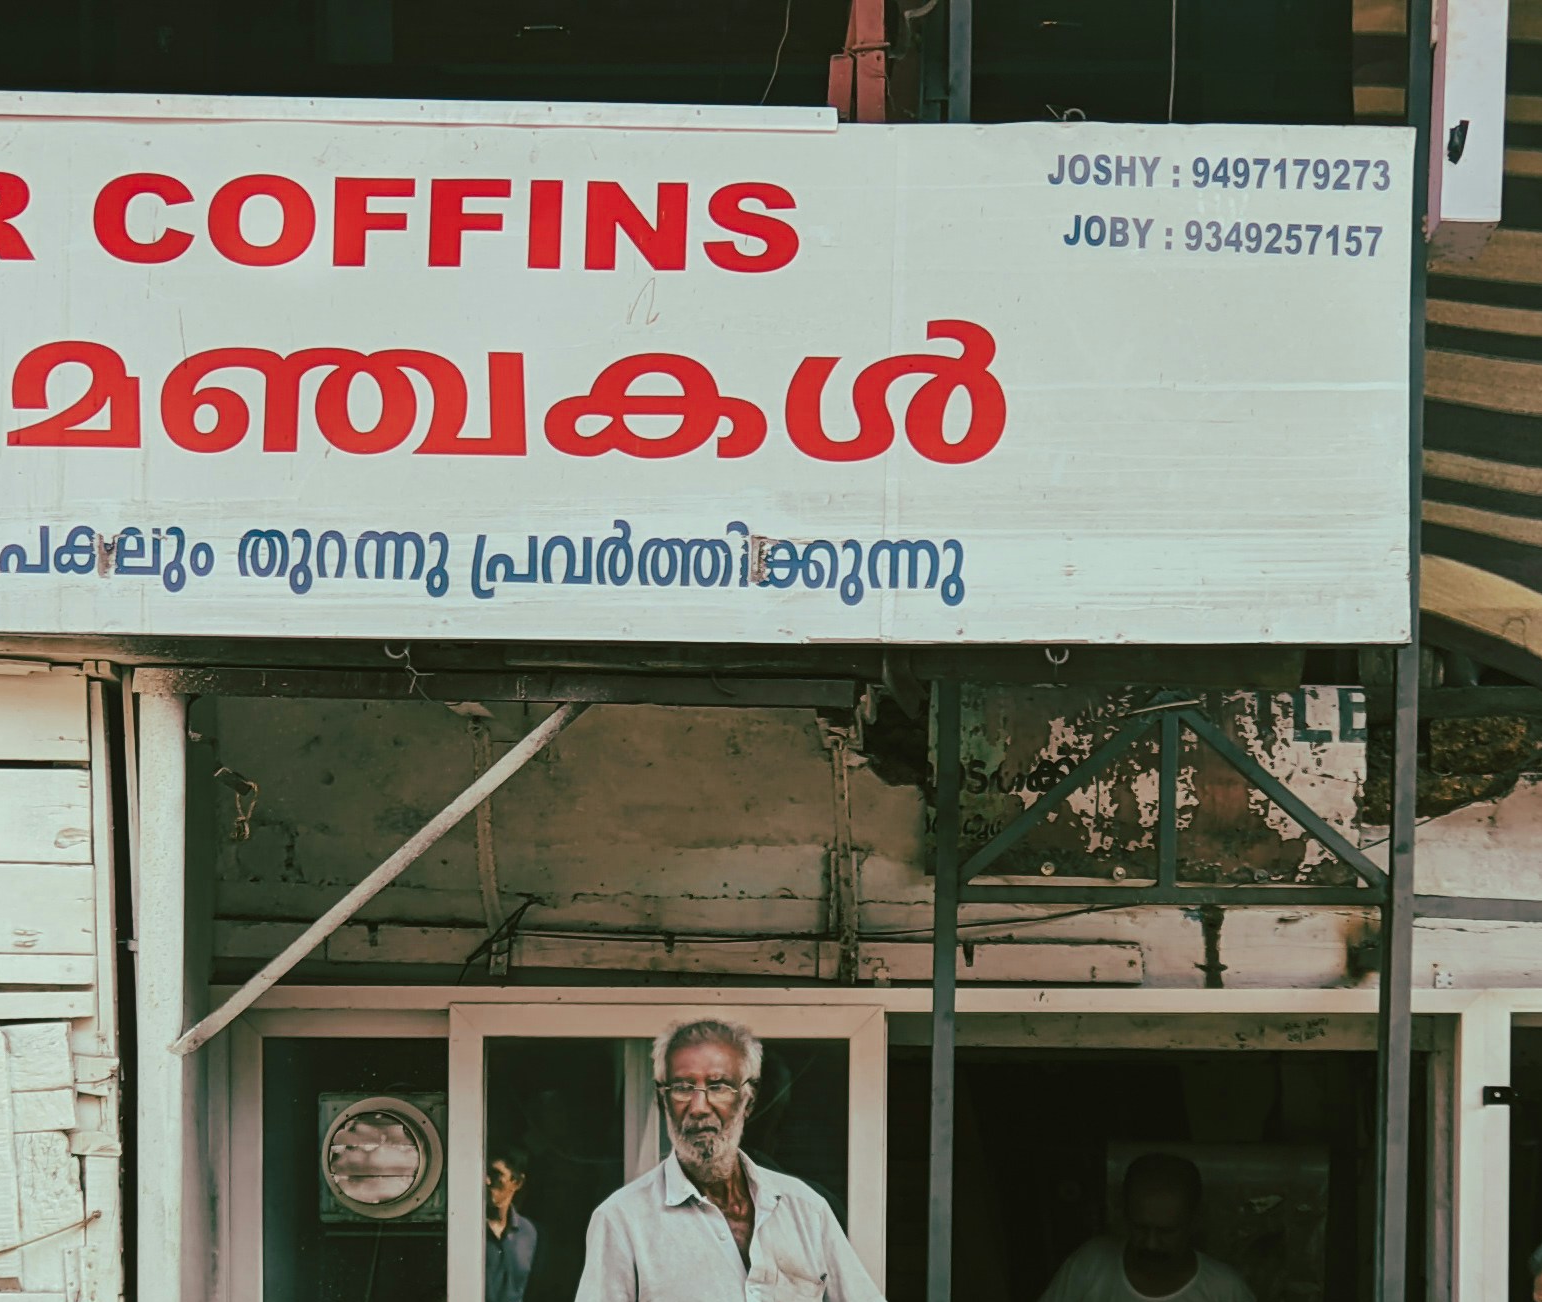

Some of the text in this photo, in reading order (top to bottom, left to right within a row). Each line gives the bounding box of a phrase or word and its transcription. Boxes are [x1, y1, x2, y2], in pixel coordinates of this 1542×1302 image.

[1047, 154, 1161, 187] JOSHY
[1192, 157, 1391, 191] 9497179273
[93, 172, 800, 273] COFFINS
[1063, 214, 1155, 250] JOBY
[1184, 220, 1384, 257] 9349257157
[236, 527, 451, 599] തുറന്നു
